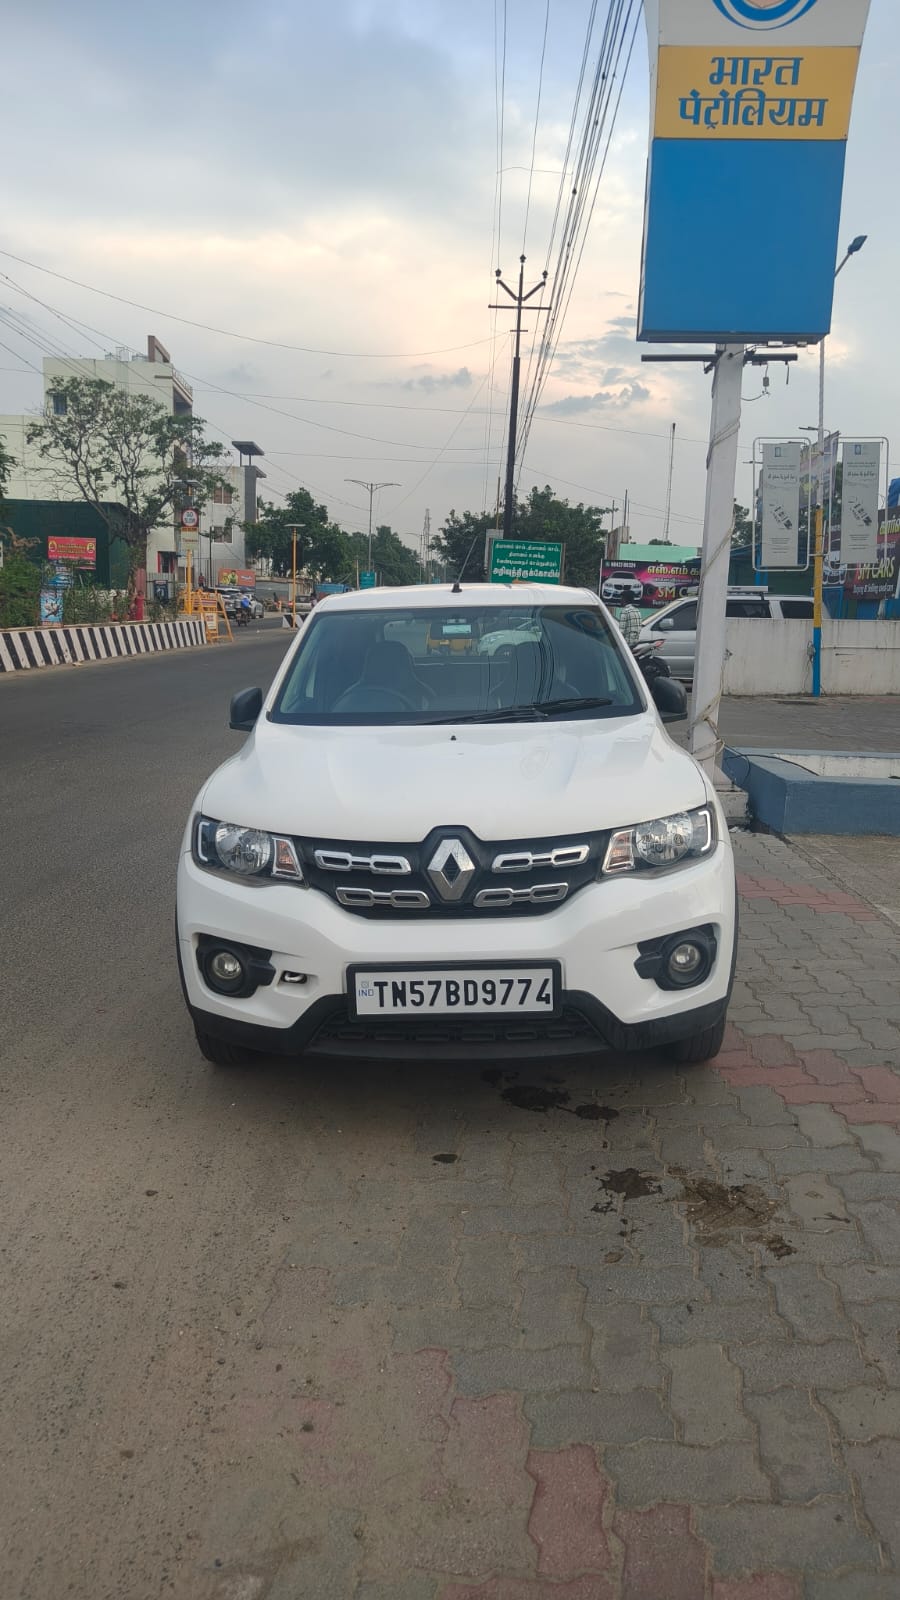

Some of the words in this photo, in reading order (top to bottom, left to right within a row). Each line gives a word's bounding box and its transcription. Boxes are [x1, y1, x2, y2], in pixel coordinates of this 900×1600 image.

[708, 57, 804, 86] भारत
[678, 88, 829, 129] पेट्रोलियम
[657, 586, 676, 598] SM
[358, 988, 375, 997] IND
[373, 978, 551, 1008] TN57BD9774
